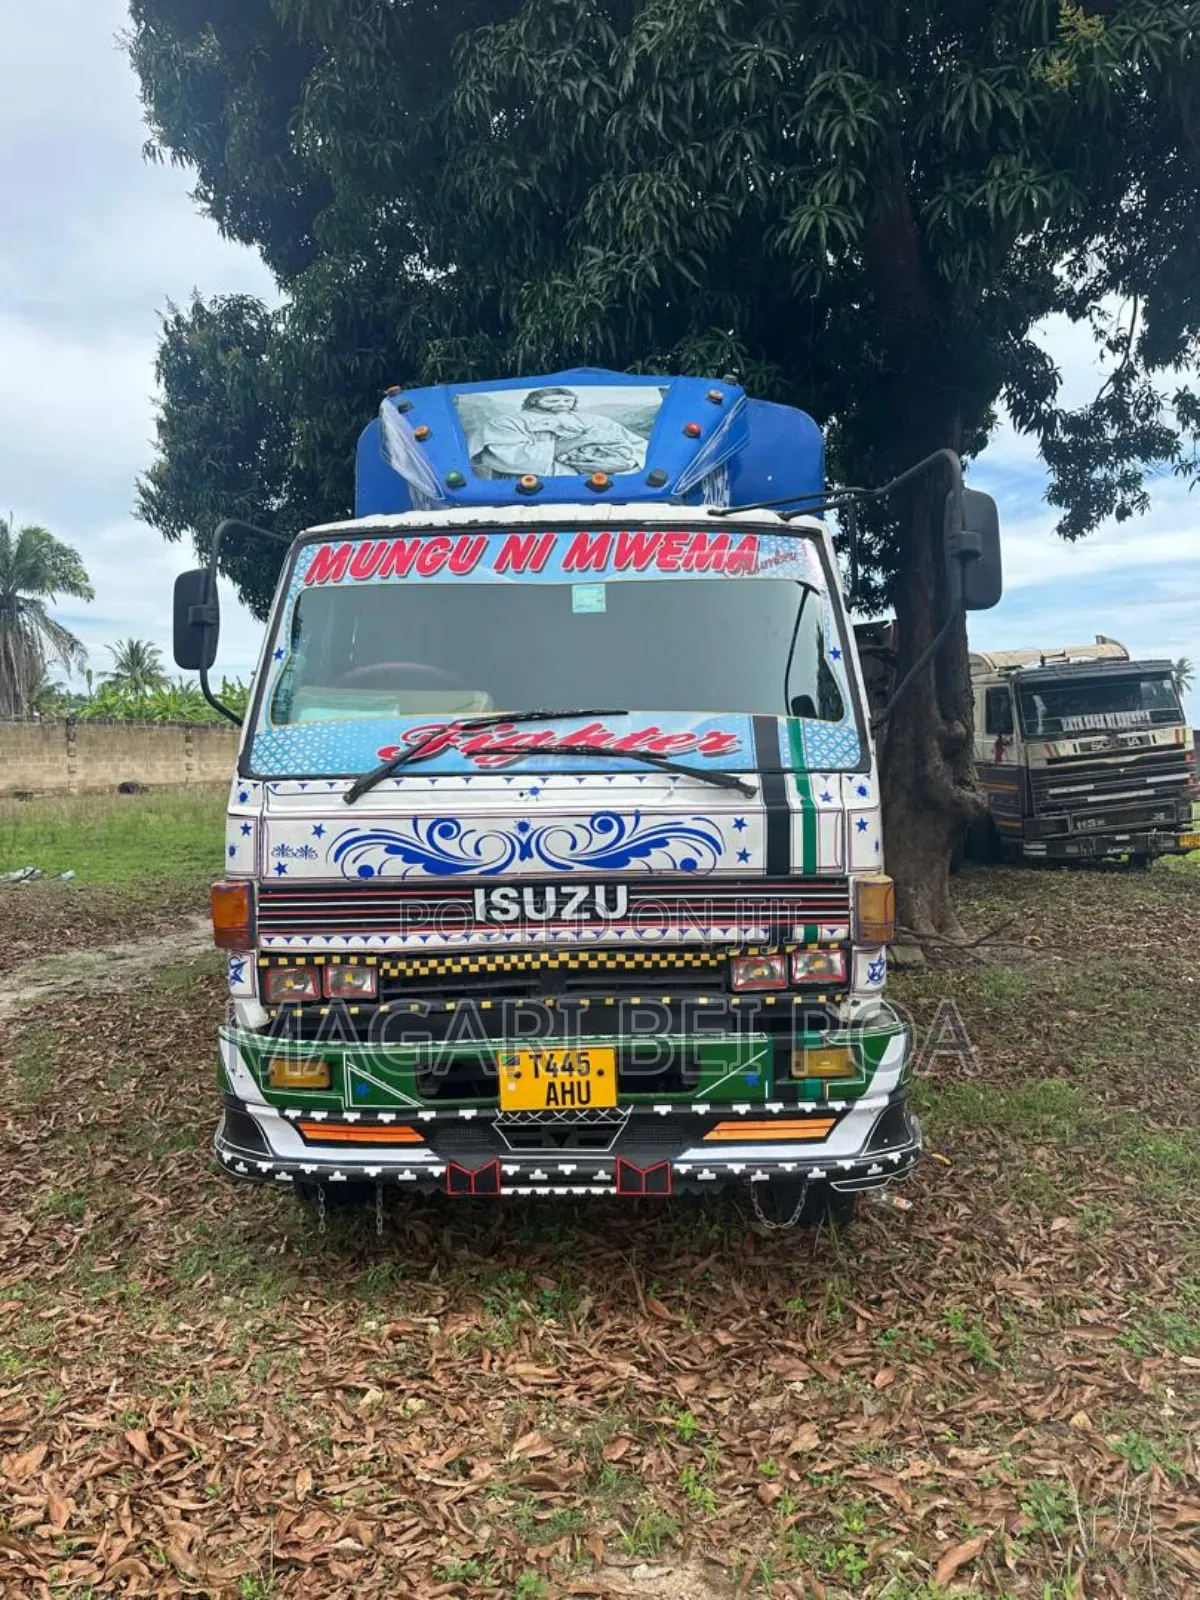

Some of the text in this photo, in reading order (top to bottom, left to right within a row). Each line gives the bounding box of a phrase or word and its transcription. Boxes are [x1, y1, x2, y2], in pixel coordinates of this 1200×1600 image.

[303, 531, 760, 584] MUNGU NI MWEMA
[377, 723, 742, 769] Fighter
[474, 885, 628, 922] ISUZU
[529, 1052, 591, 1079] T445
[546, 1080, 592, 1106] AHU
